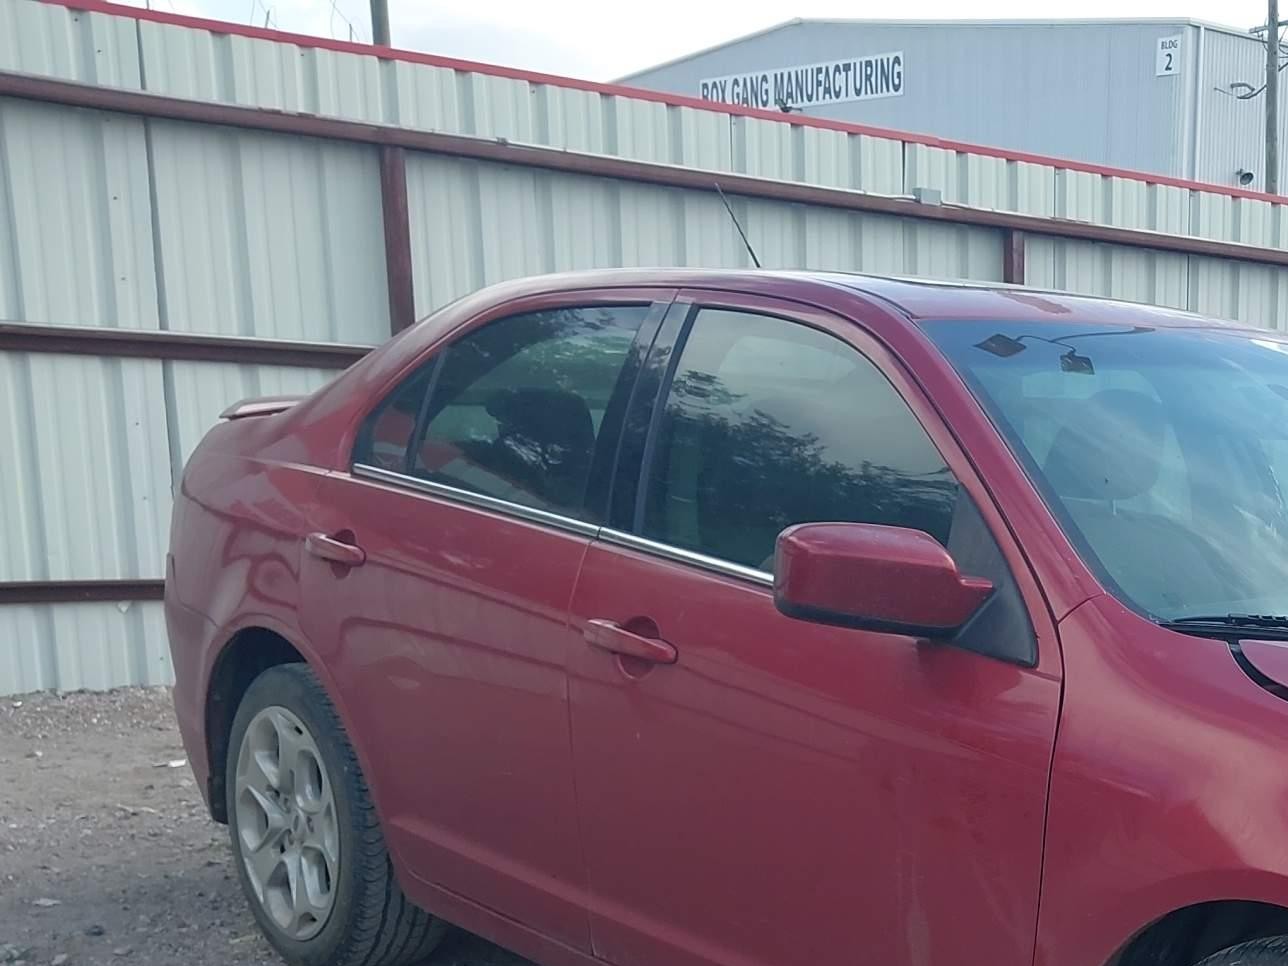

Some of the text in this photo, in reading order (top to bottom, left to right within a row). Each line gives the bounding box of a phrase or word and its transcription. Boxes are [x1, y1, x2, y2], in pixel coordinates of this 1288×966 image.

[1165, 53, 1173, 71] 2
[731, 74, 769, 109] GANG
[774, 55, 902, 107] MANUFACTURING
